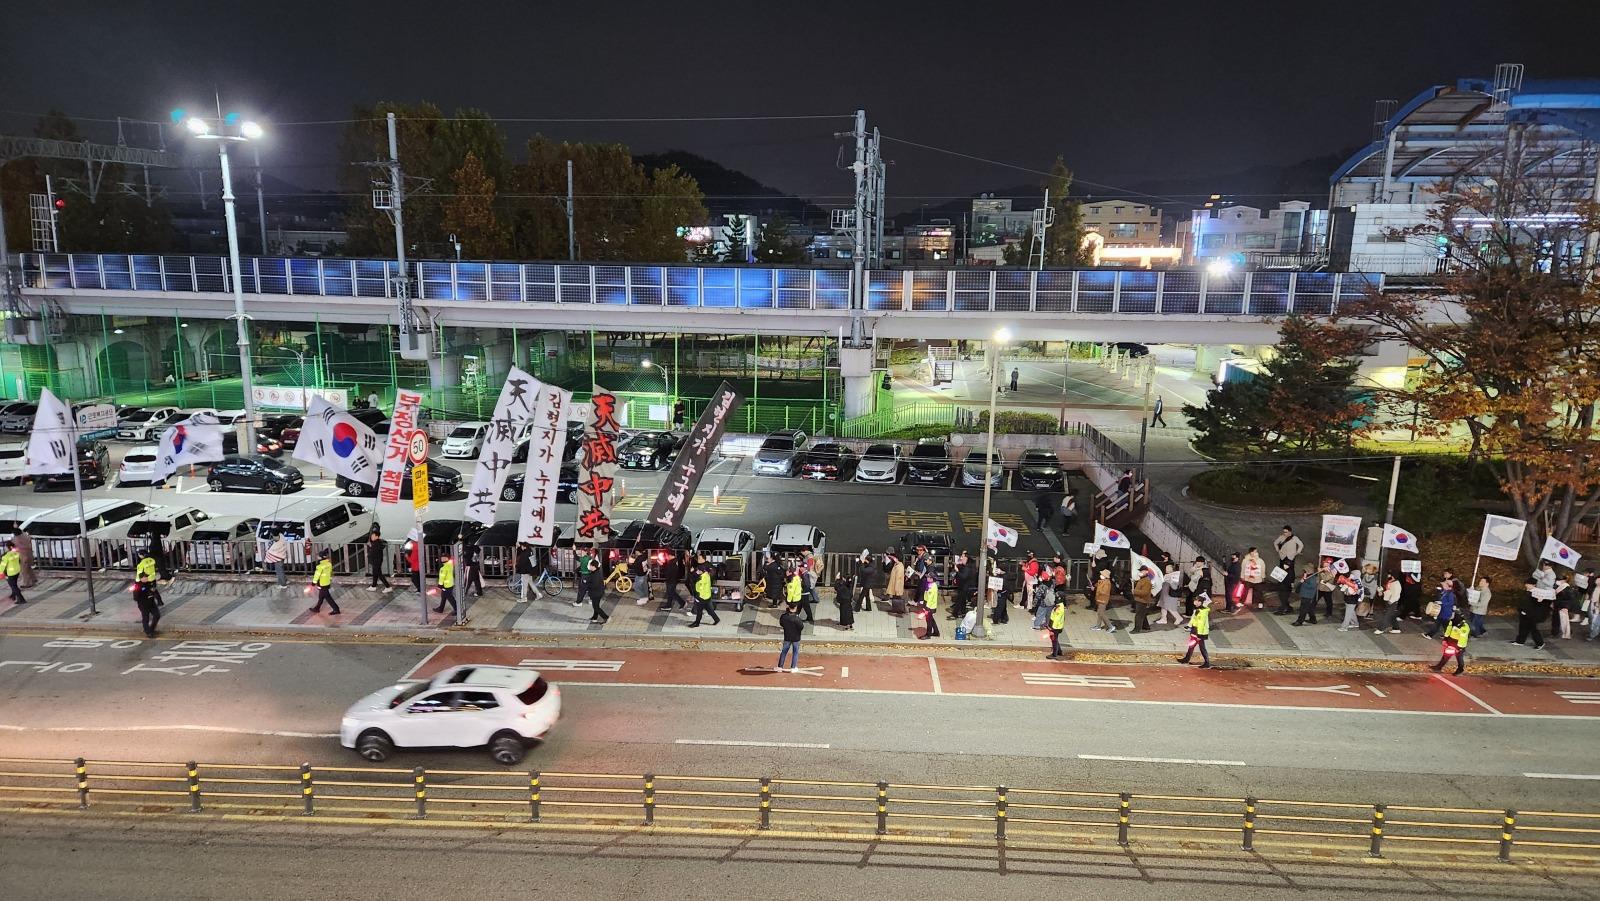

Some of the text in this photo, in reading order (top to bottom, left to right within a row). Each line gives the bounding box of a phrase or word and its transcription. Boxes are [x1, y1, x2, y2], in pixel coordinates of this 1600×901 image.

[412, 439, 424, 455] 50
[538, 391, 562, 463] 김현지가
[380, 470, 403, 504] 척결
[577, 392, 621, 539] 天滅中共
